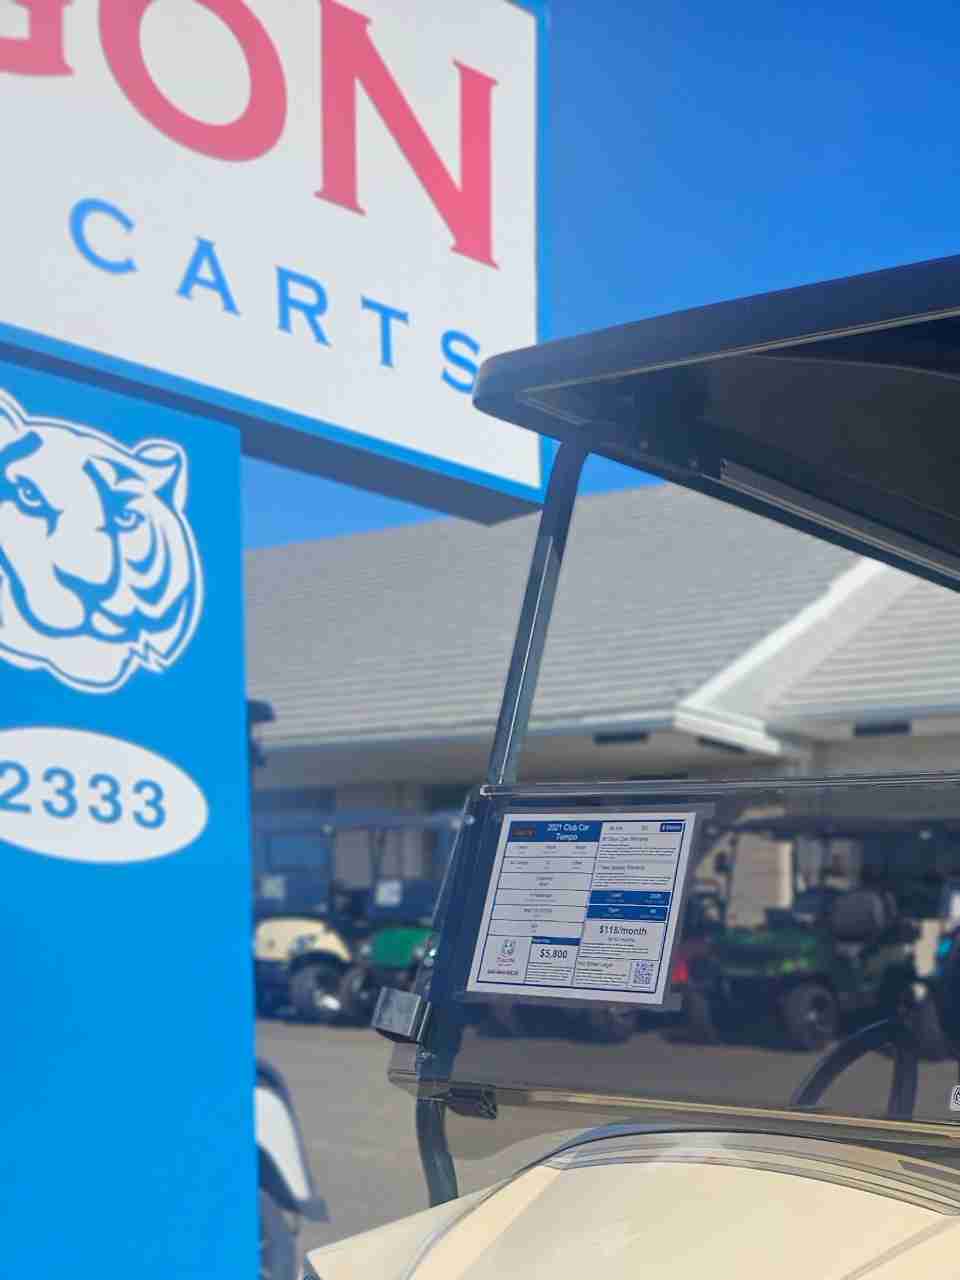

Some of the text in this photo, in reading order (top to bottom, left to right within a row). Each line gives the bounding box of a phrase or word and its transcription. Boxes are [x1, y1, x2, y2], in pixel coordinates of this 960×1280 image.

[69, 197, 481, 396] CARTS
[0, 760, 166, 830] 2333
[563, 823, 578, 832] Club
